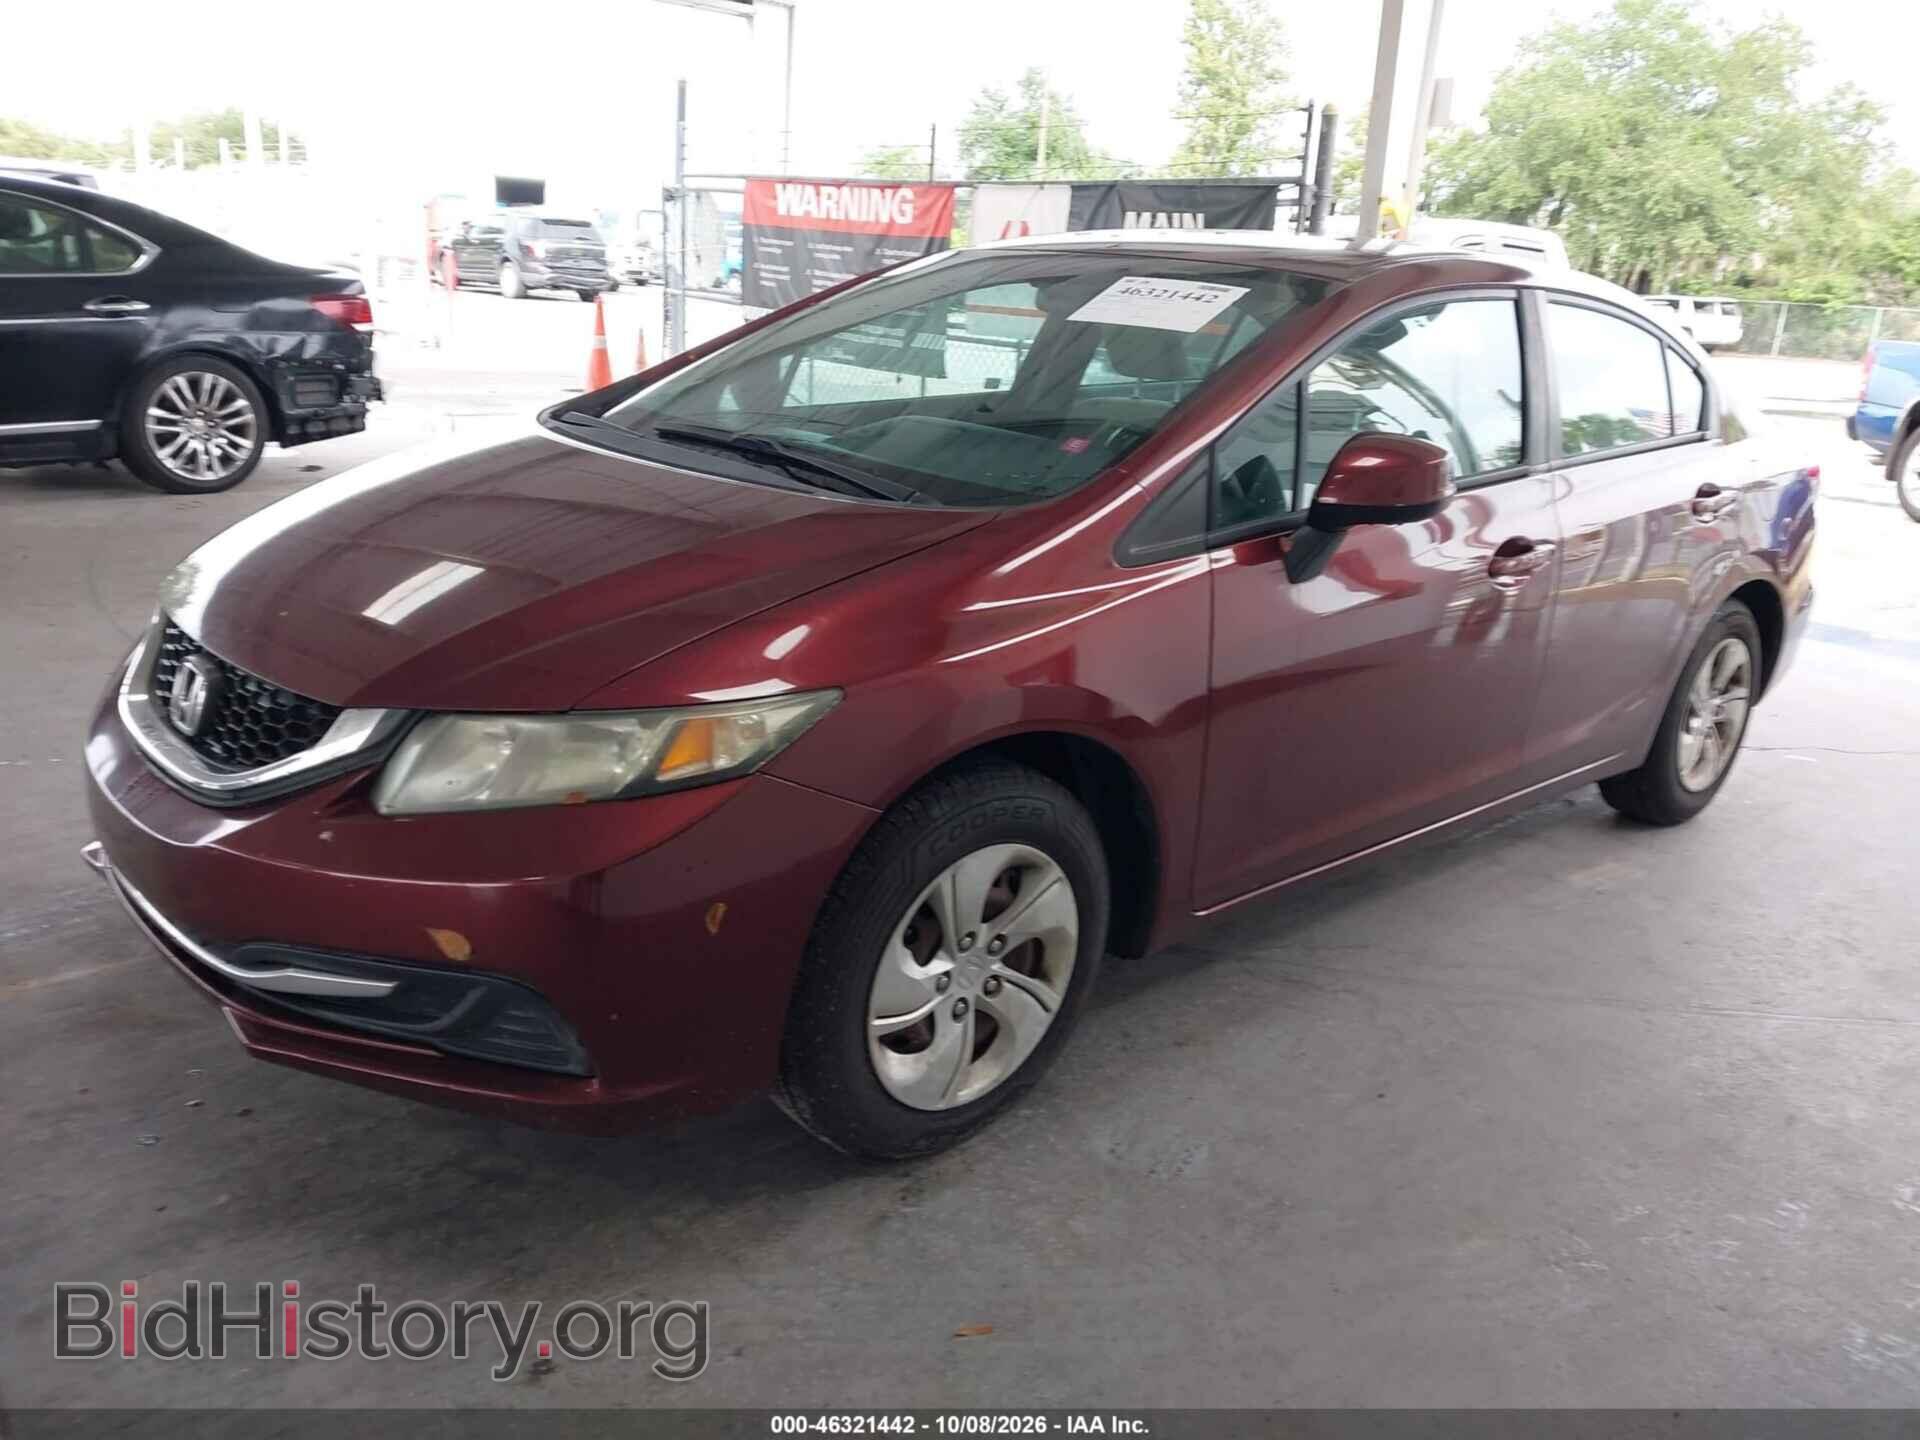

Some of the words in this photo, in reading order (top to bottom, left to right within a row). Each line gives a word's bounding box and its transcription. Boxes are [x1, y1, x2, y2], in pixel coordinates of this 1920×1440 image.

[774, 183, 915, 224] WARNING
[1118, 286, 1219, 303] 46321442
[930, 805, 1049, 857] COOPER
